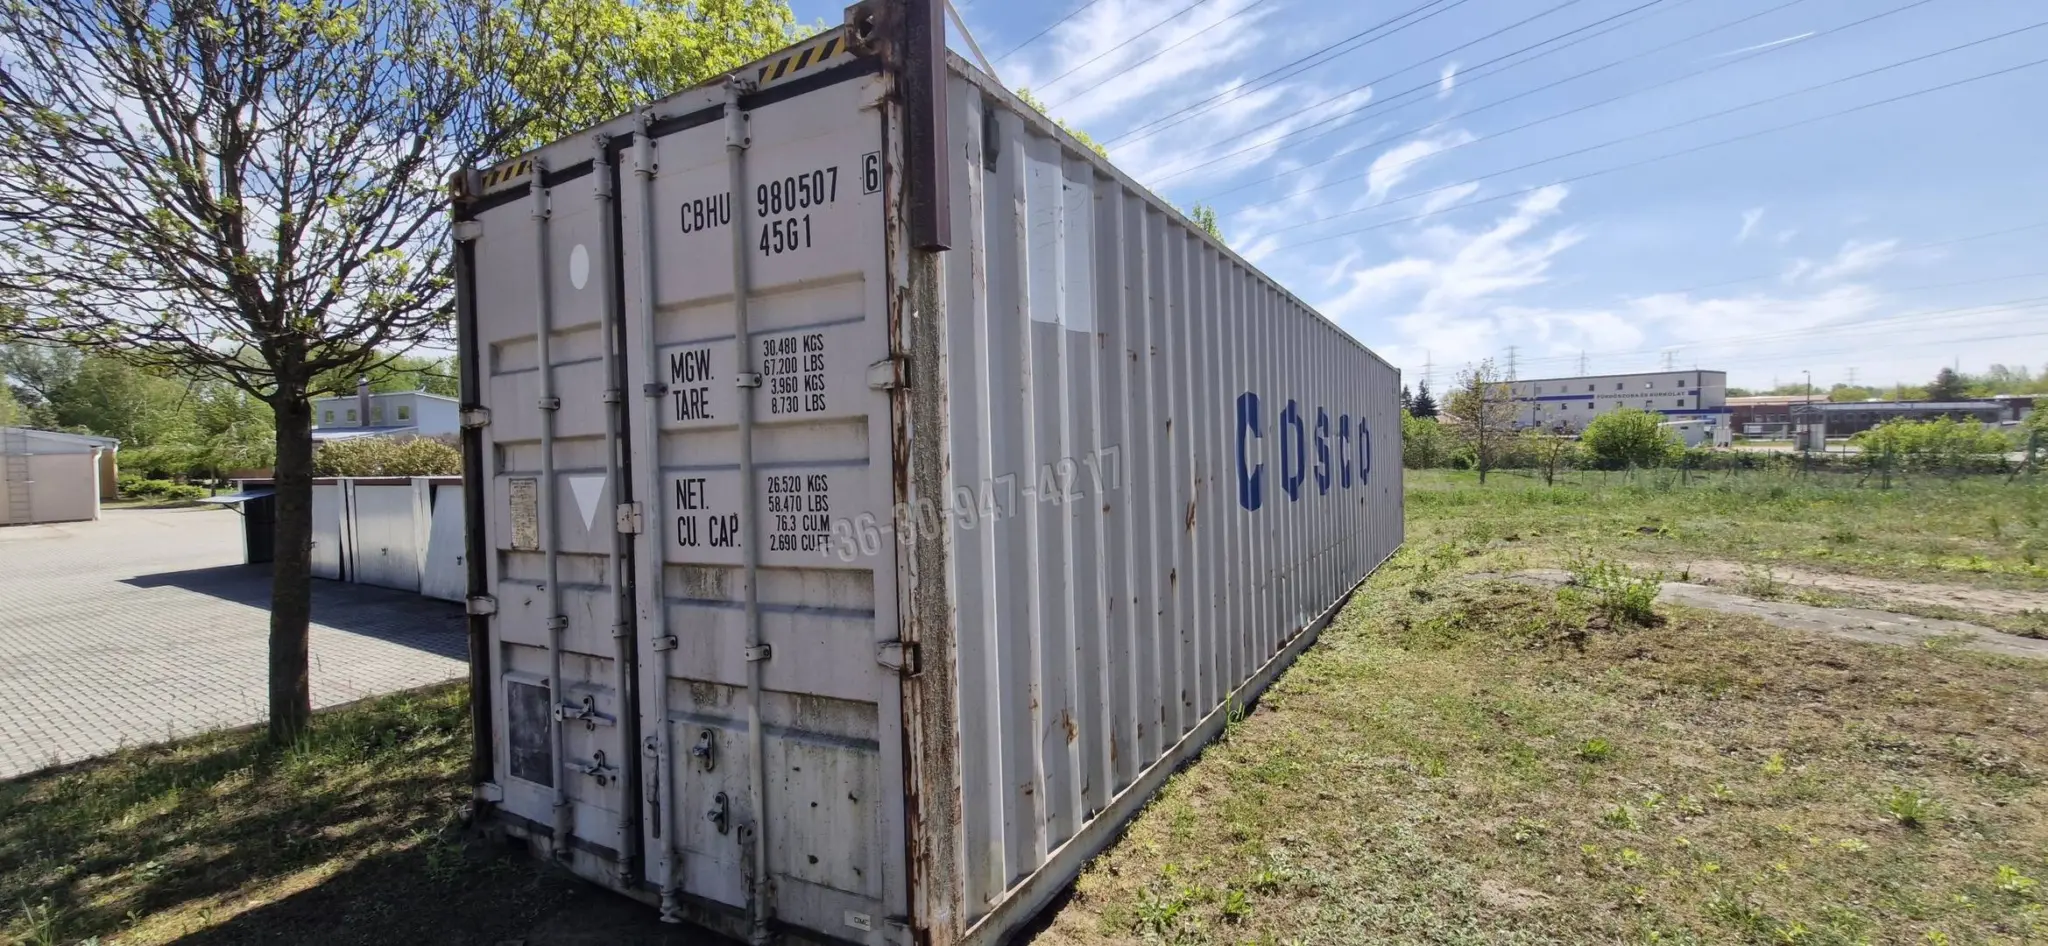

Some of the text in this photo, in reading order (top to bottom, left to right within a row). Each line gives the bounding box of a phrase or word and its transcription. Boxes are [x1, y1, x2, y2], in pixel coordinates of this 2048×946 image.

[681, 154, 878, 234] CBHU 980507 6
[759, 214, 812, 256] 45G1
[671, 334, 824, 384] MGW. 30.480 KGS
[763, 354, 825, 376] 67.200 LBS
[673, 374, 825, 421] TARE. 3.960 KGS
[771, 394, 826, 414] 8.730 LBS
[1236, 391, 1371, 512] COSCO
[676, 474, 829, 510] NET. 26.520 KGS
[768, 494, 829, 513] 58.470 LBS
[677, 514, 830, 548] CU. CAP. 76.3 CU.M
[770, 534, 797, 552] 2.690
